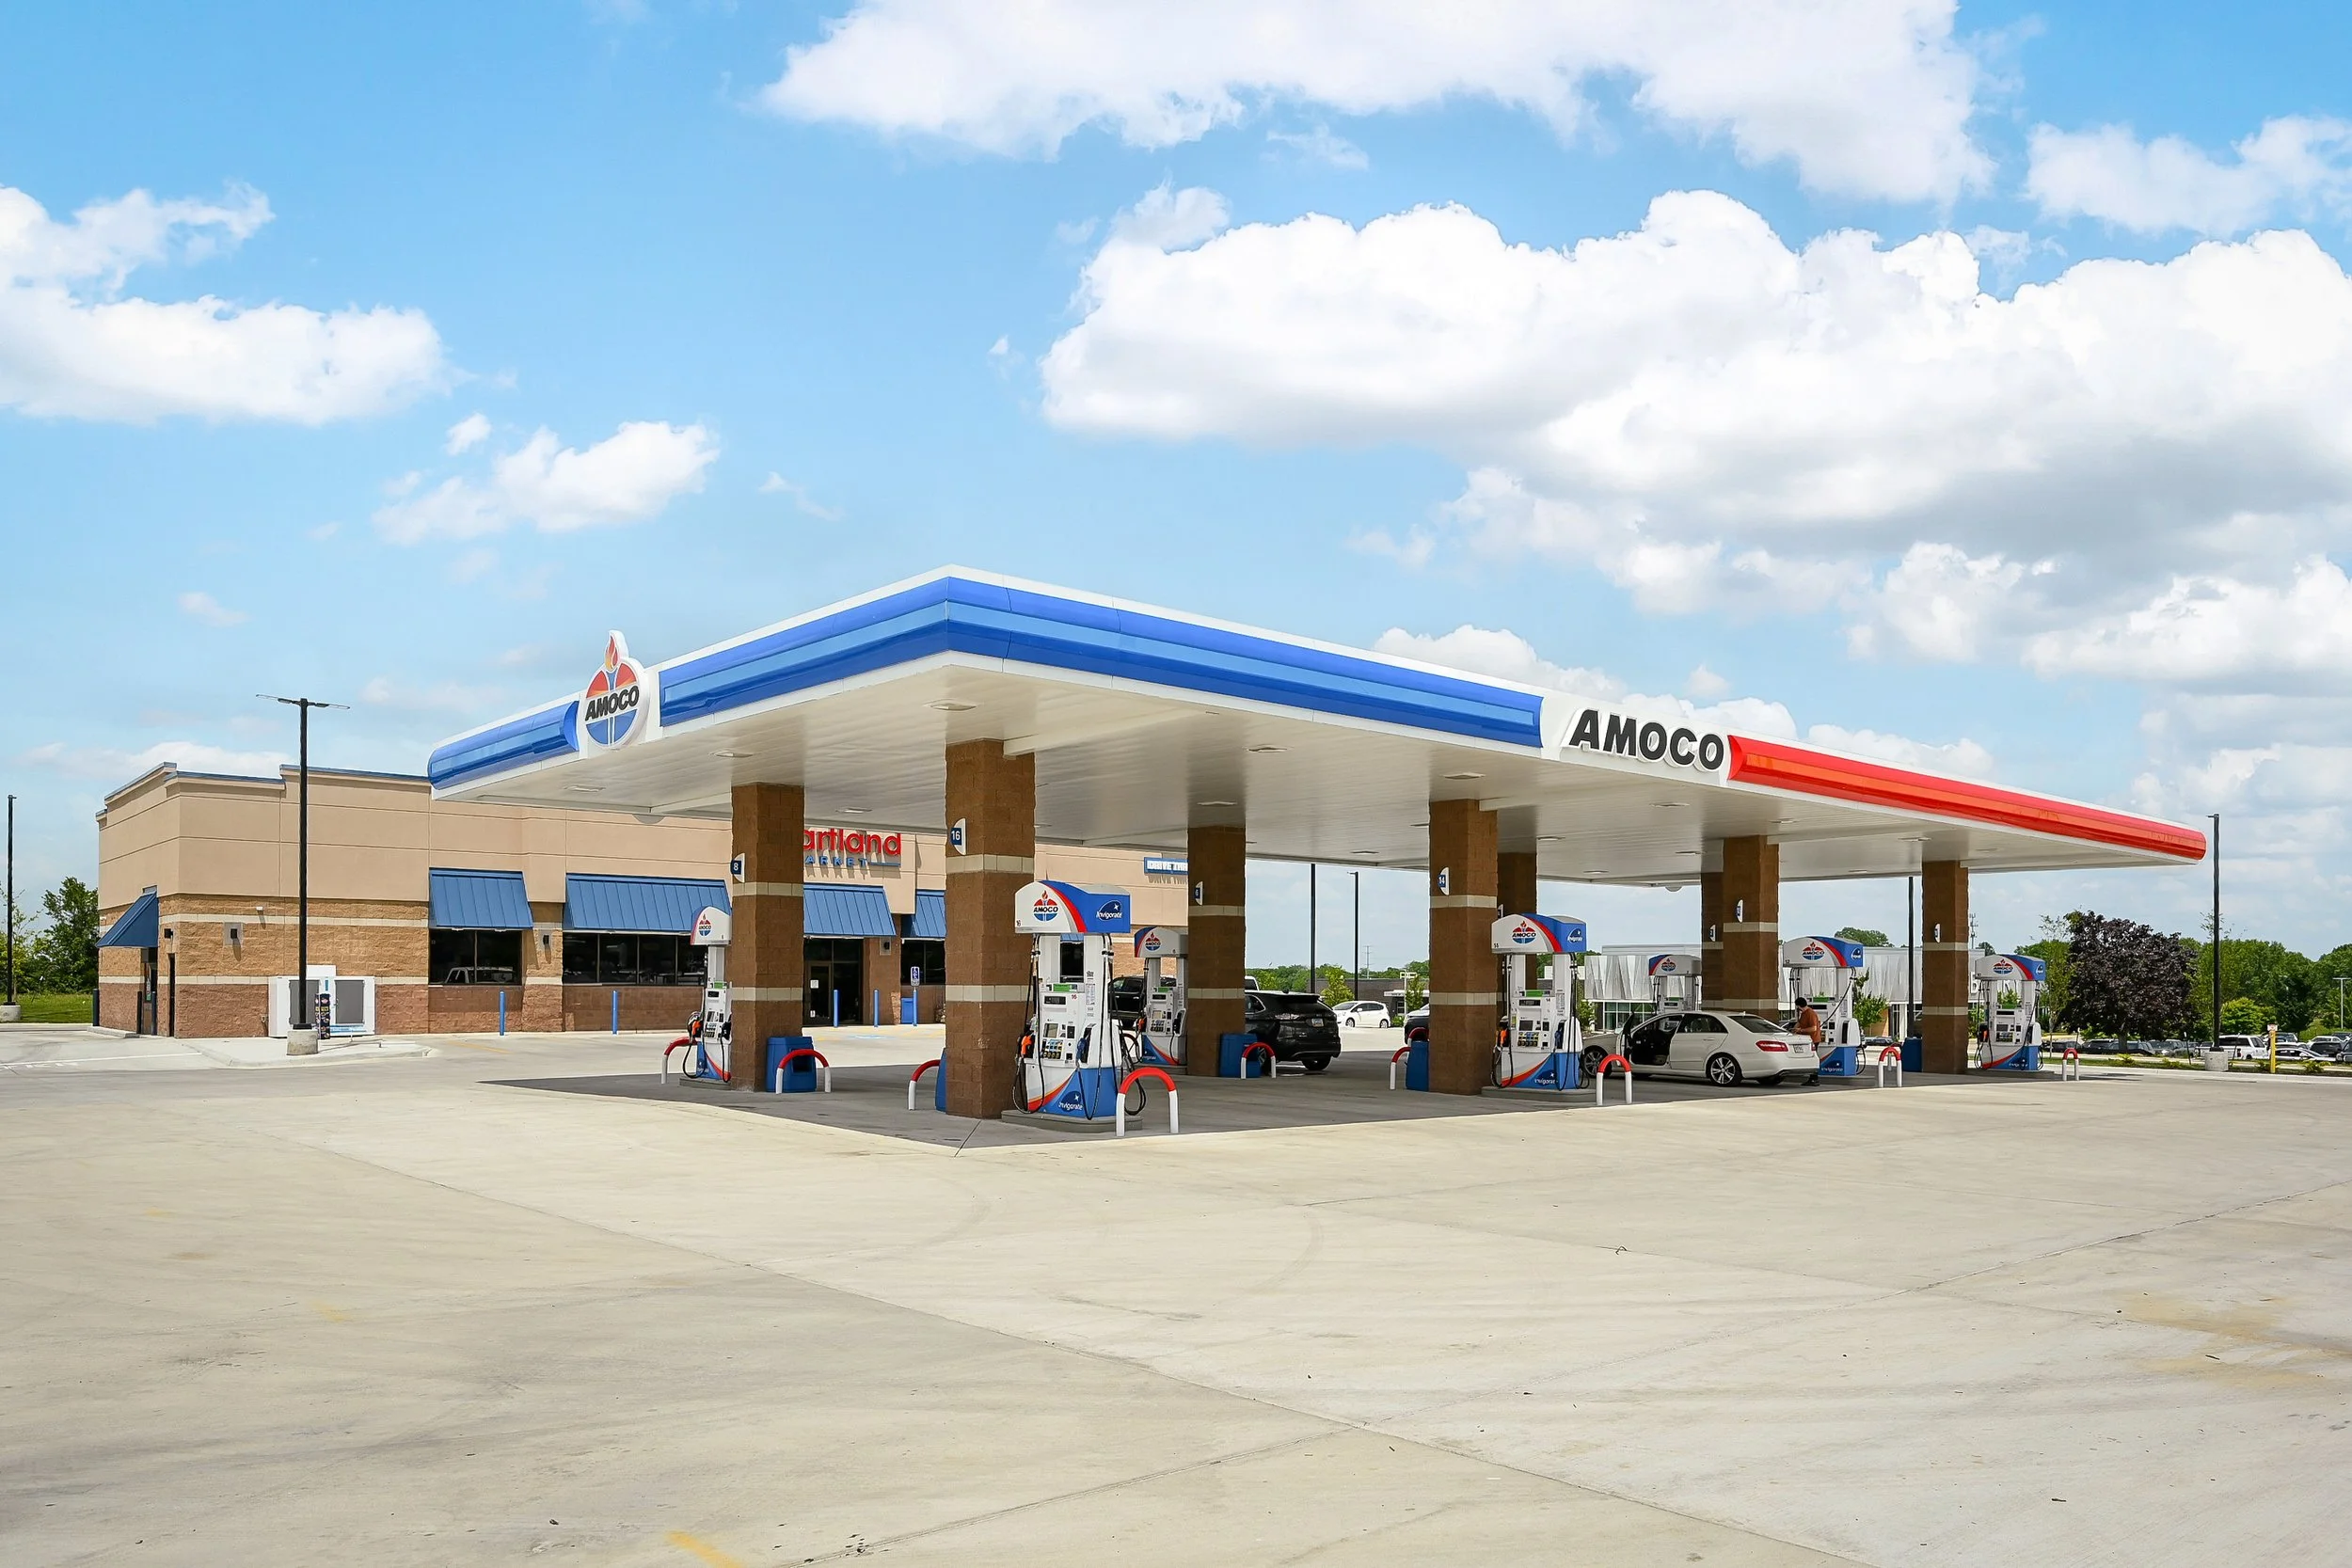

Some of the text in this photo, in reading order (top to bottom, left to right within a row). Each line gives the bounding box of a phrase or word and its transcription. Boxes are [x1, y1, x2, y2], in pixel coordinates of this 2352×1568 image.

[584, 686, 640, 721] AMOCO
[1567, 709, 1724, 770] AMOCO
[951, 831, 961, 840] 16
[803, 828, 901, 856] artland
[733, 862, 739, 871] 8
[805, 856, 867, 868] ARKET
[1171, 861, 1188, 872] THR
